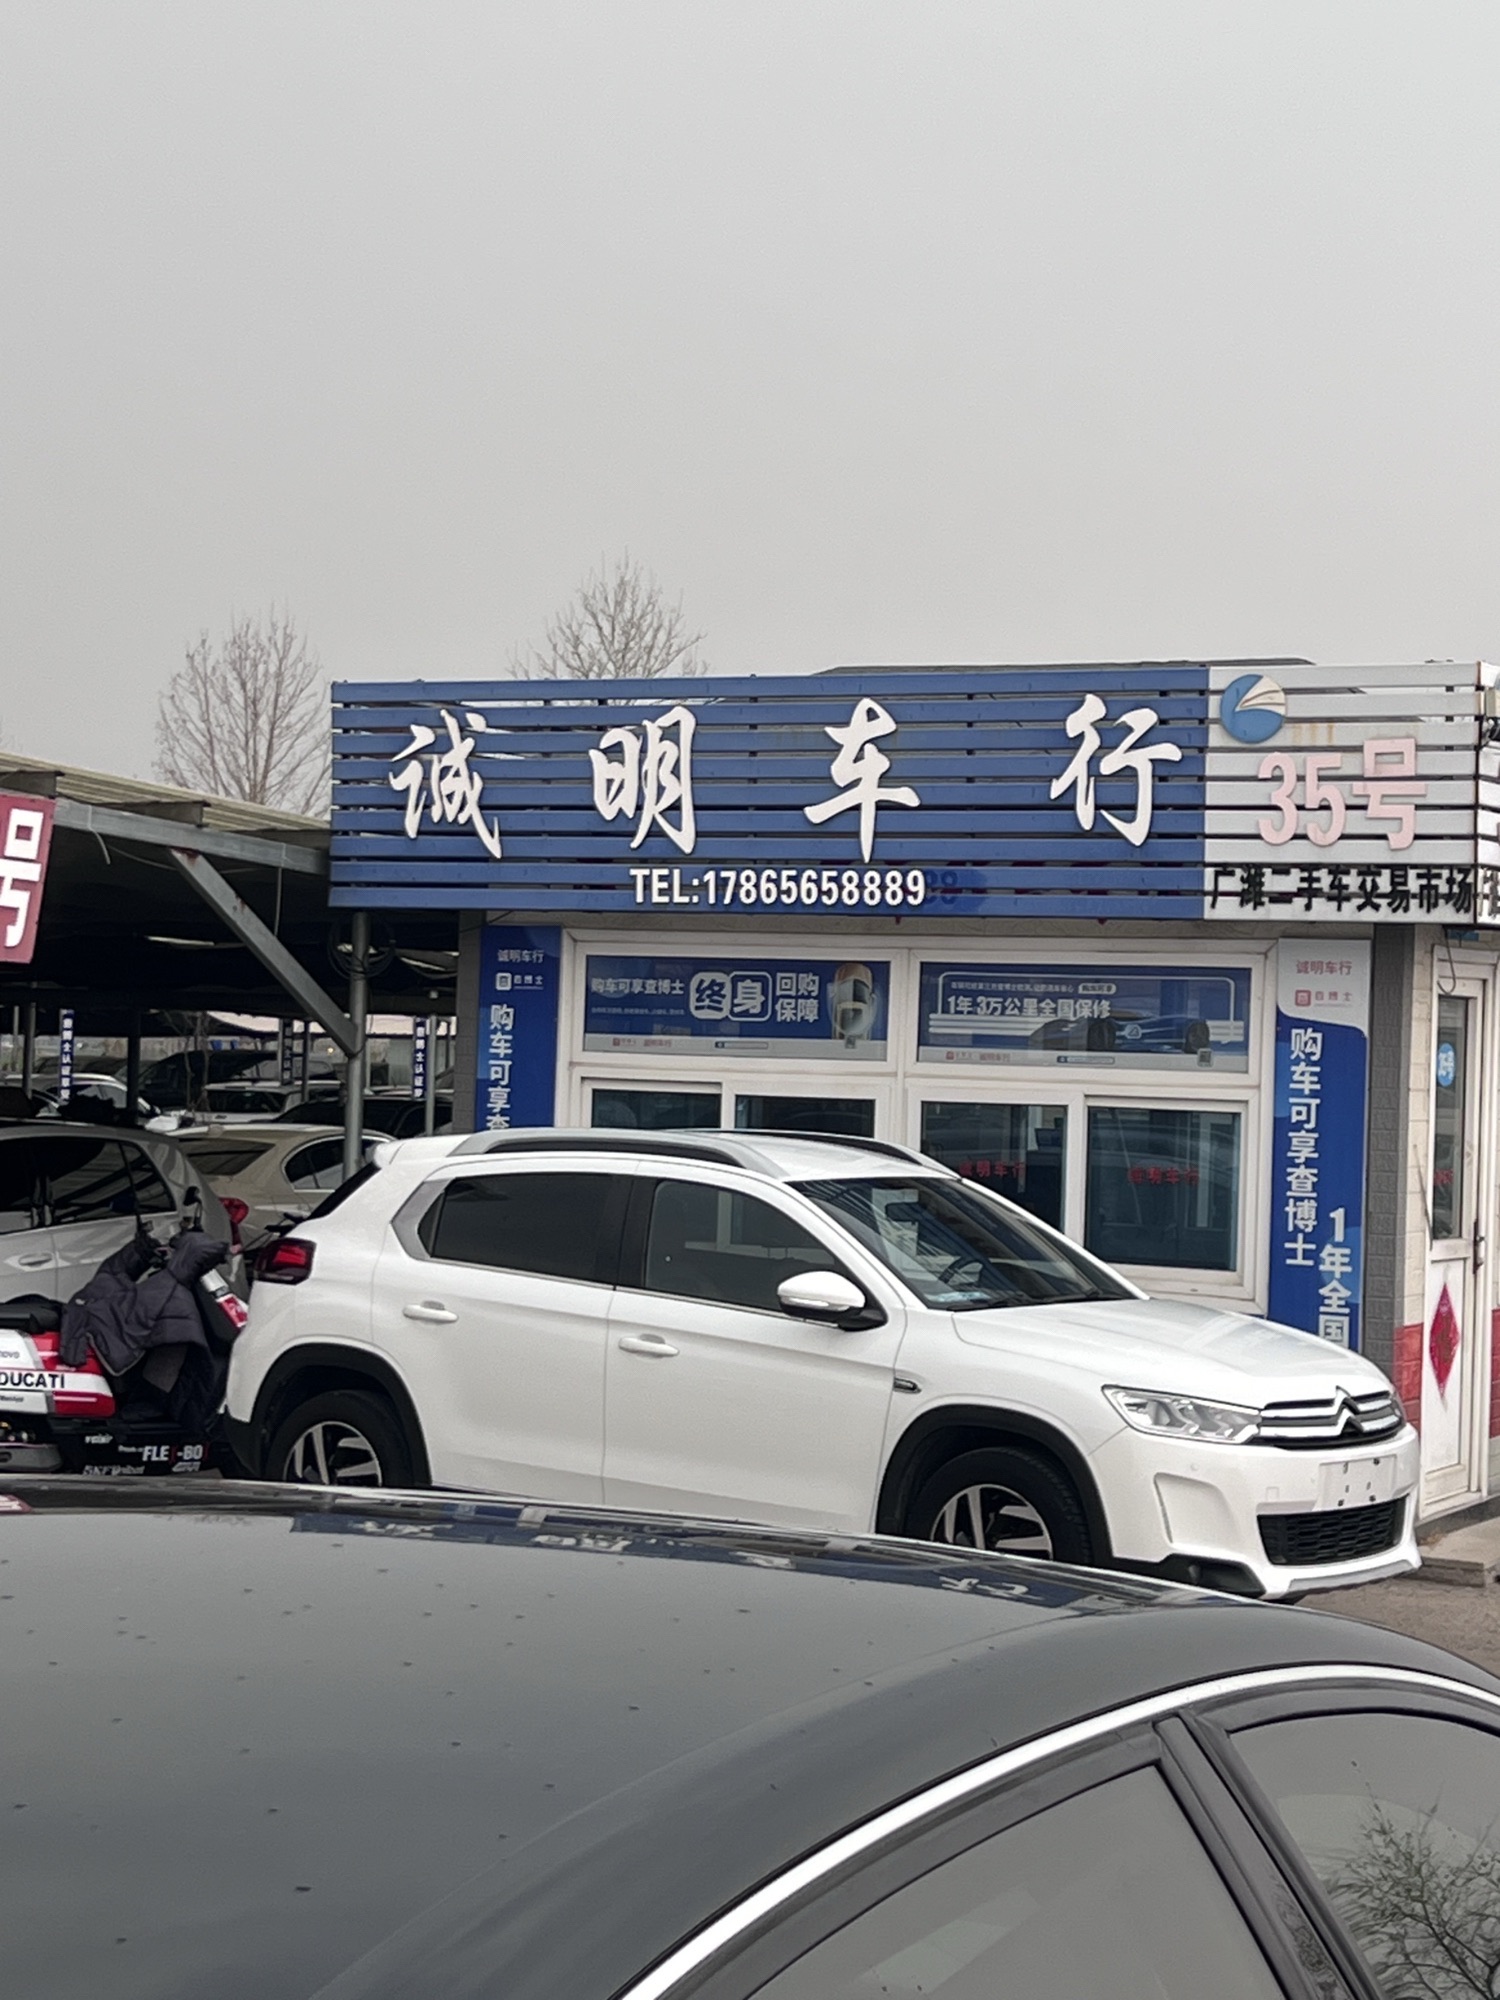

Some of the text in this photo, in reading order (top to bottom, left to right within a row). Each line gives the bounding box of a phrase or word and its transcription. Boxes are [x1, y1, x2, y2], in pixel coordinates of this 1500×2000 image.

[389, 694, 1183, 863] 诚明车行
[1257, 738, 1427, 849] 35号
[630, 868, 925, 906] TEL:17865658889
[1208, 866, 1474, 915] 广潍二手车交易市场
[497, 949, 544, 964] 诚明车行
[1296, 960, 1353, 975] 诚明车行
[694, 976, 766, 1016] 终身
[775, 973, 820, 997] 回购
[775, 998, 820, 1023] 保障
[1284, 1027, 1323, 1267] 购车可享查博士
[1318, 1207, 1353, 1348] 1年全国
[0, 1372, 65, 1389] DUCATI
